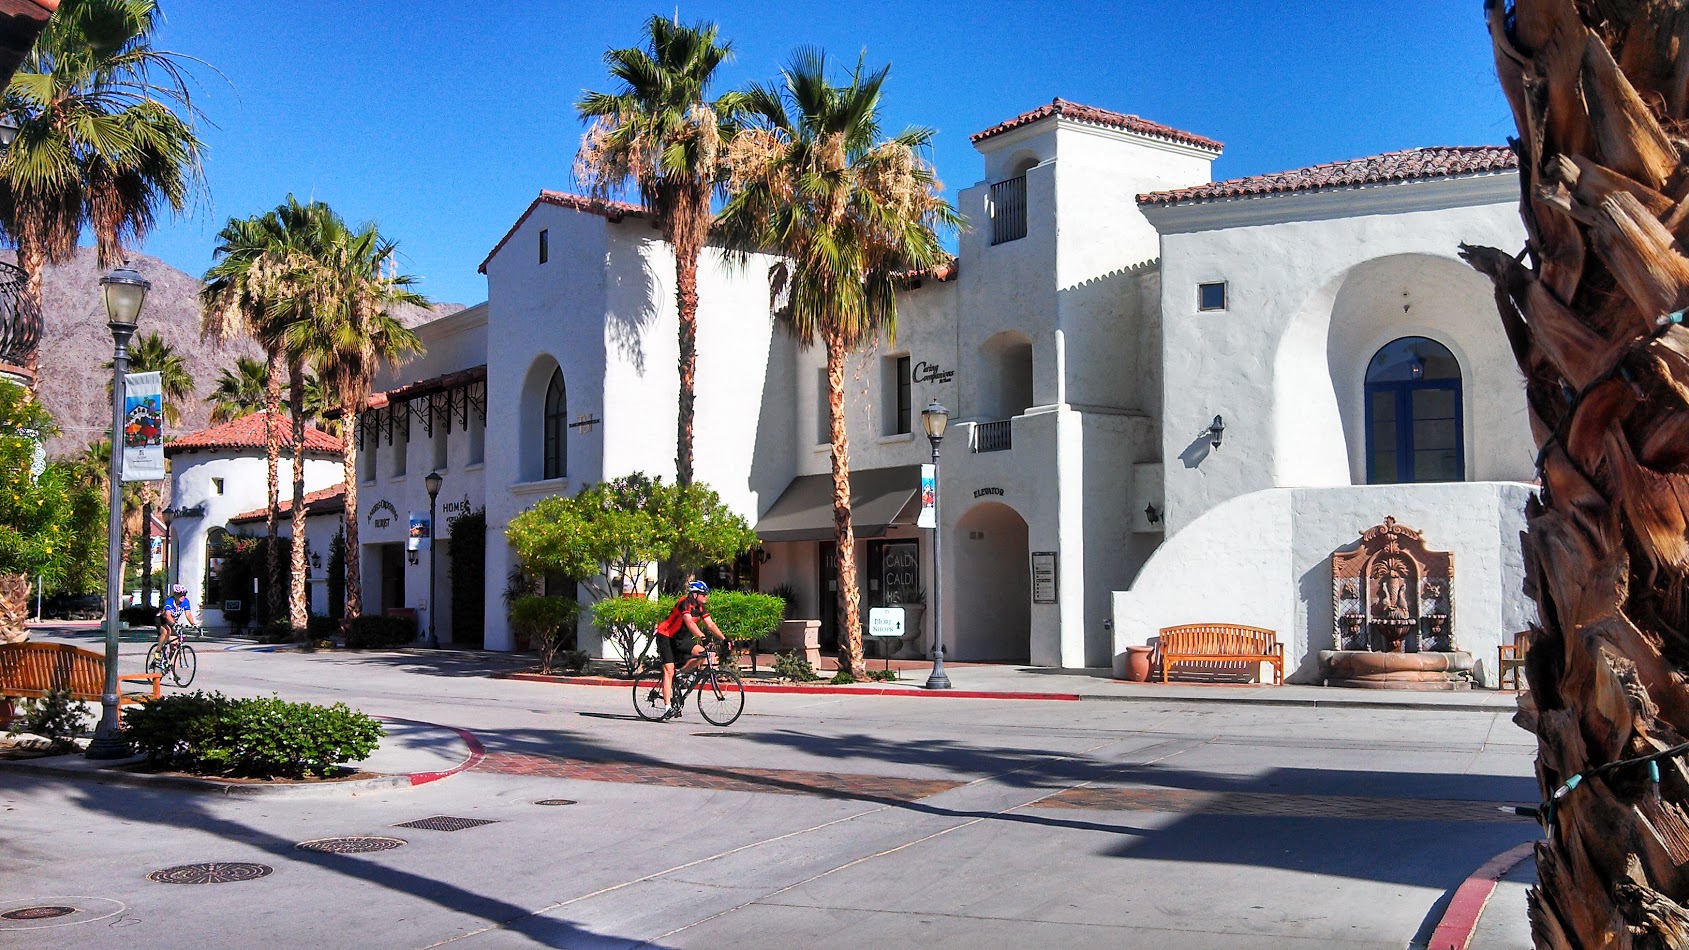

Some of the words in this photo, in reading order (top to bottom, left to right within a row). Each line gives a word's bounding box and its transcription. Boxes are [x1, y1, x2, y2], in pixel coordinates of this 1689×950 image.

[912, 361, 939, 381] Caring
[973, 487, 1004, 498] ELEVATOR
[887, 554, 914, 567] CALDI
[887, 572, 914, 585] CALDI
